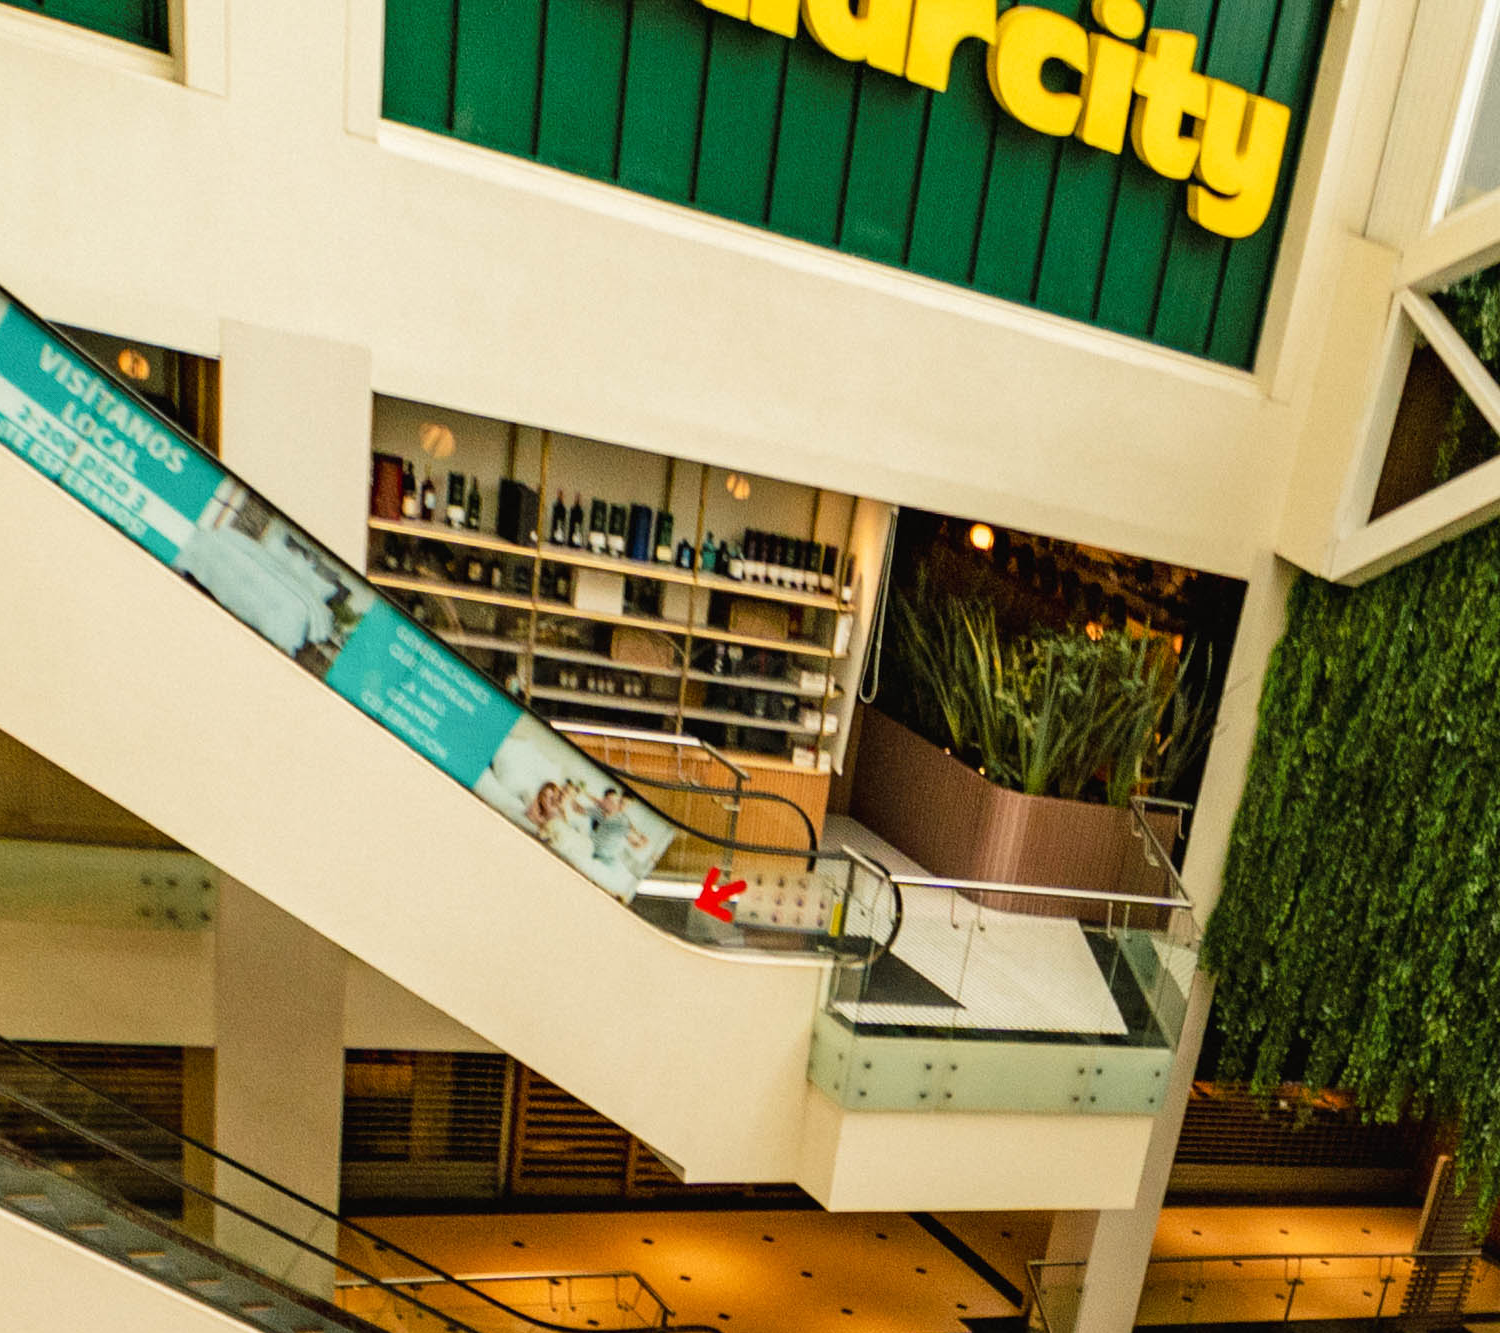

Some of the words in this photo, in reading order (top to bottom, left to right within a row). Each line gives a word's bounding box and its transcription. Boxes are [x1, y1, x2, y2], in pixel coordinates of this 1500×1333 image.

[36, 342, 190, 474] VISÍTANOS
[59, 401, 140, 473] LOCAL
[77, 452, 130, 500] piso
